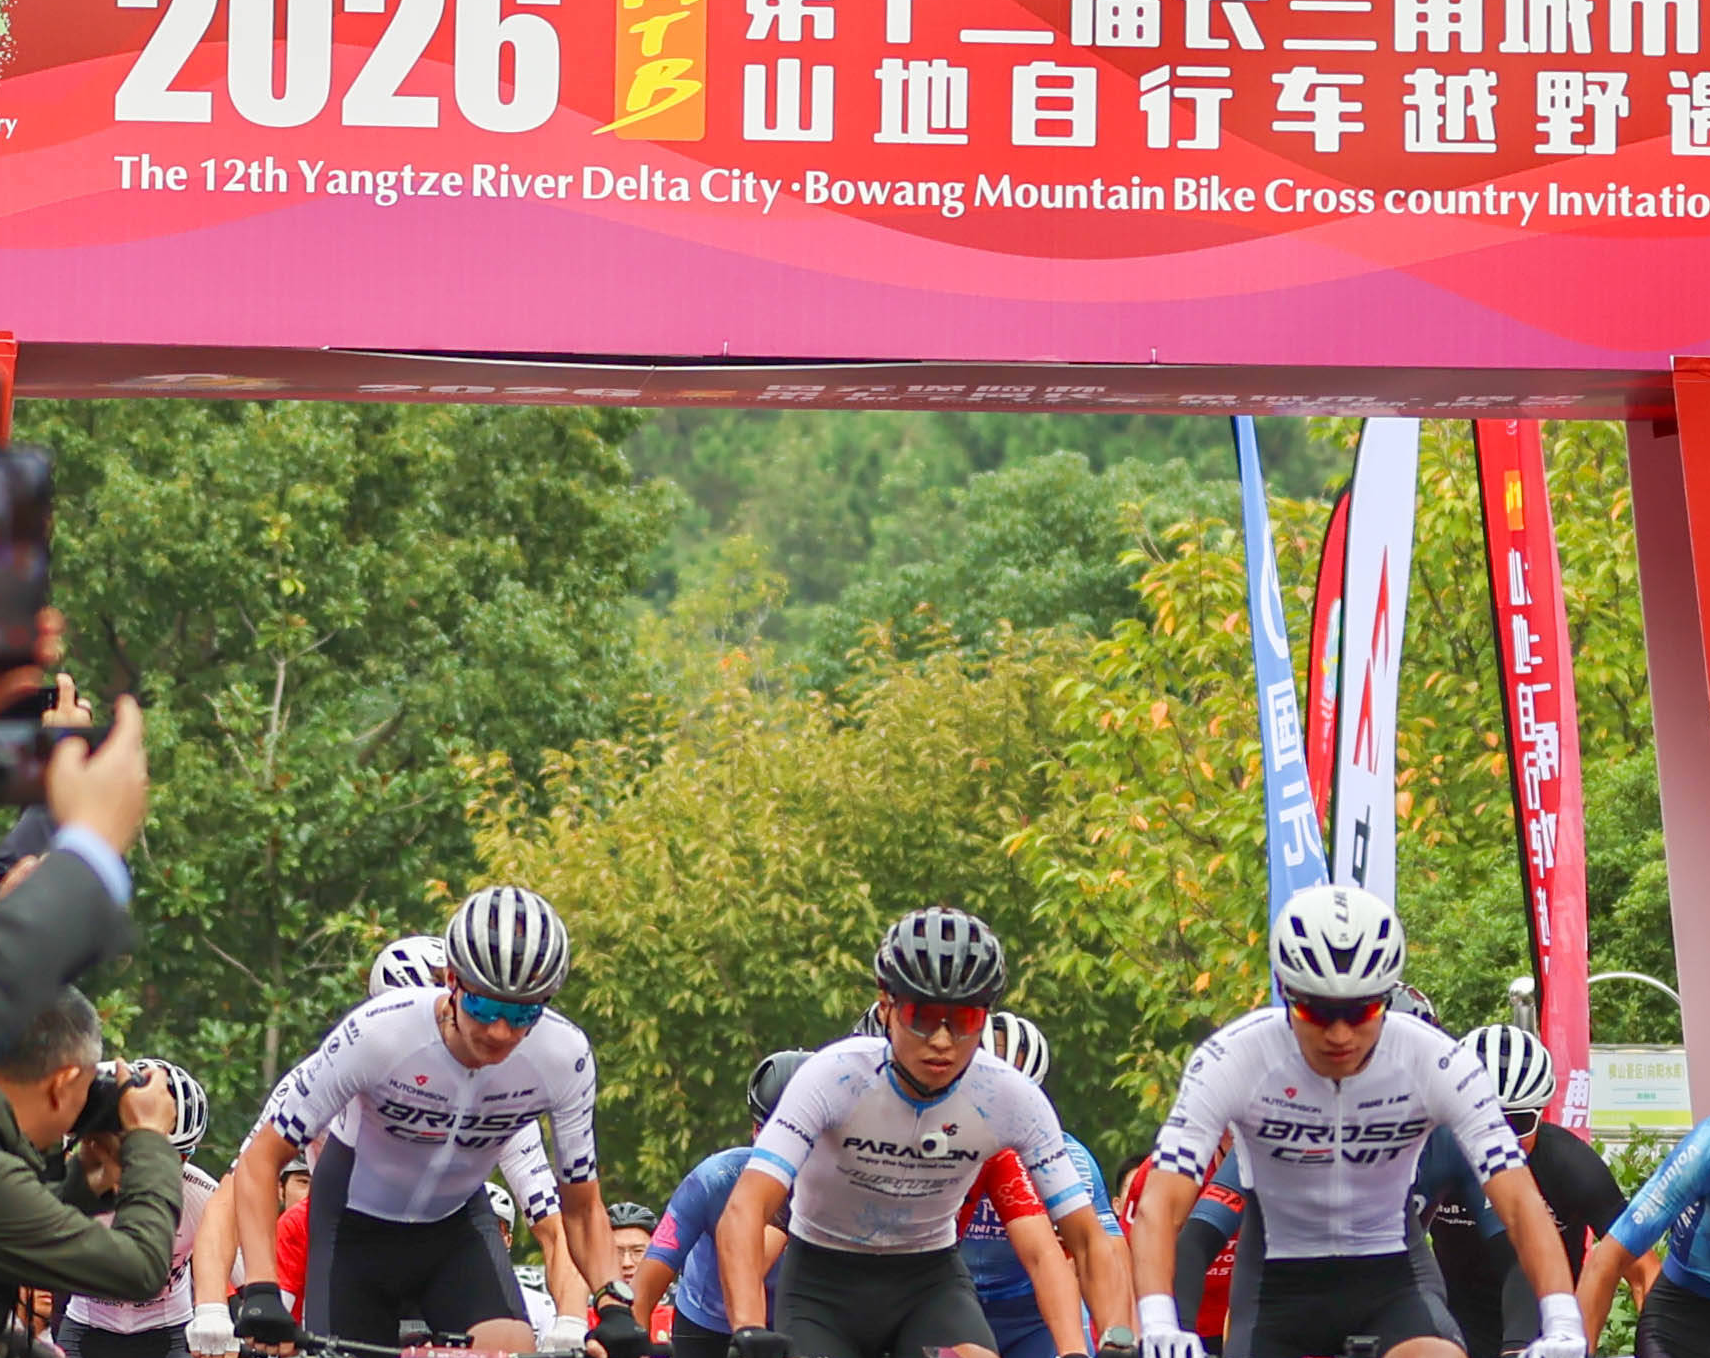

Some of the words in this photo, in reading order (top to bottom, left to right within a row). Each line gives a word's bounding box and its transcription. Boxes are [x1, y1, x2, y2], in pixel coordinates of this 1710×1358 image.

[114, 154, 196, 191] The
[204, 155, 289, 193] 12th
[297, 159, 464, 208] Yangtze
[472, 163, 573, 199] River
[582, 165, 691, 202] Delta
[700, 169, 782, 215] City
[975, 175, 1166, 211] Mountain
[1174, 176, 1256, 213] Bike
[1264, 179, 1375, 215] Cross
[1384, 189, 1540, 229] country
[842, 1136, 980, 1162] PARAON
